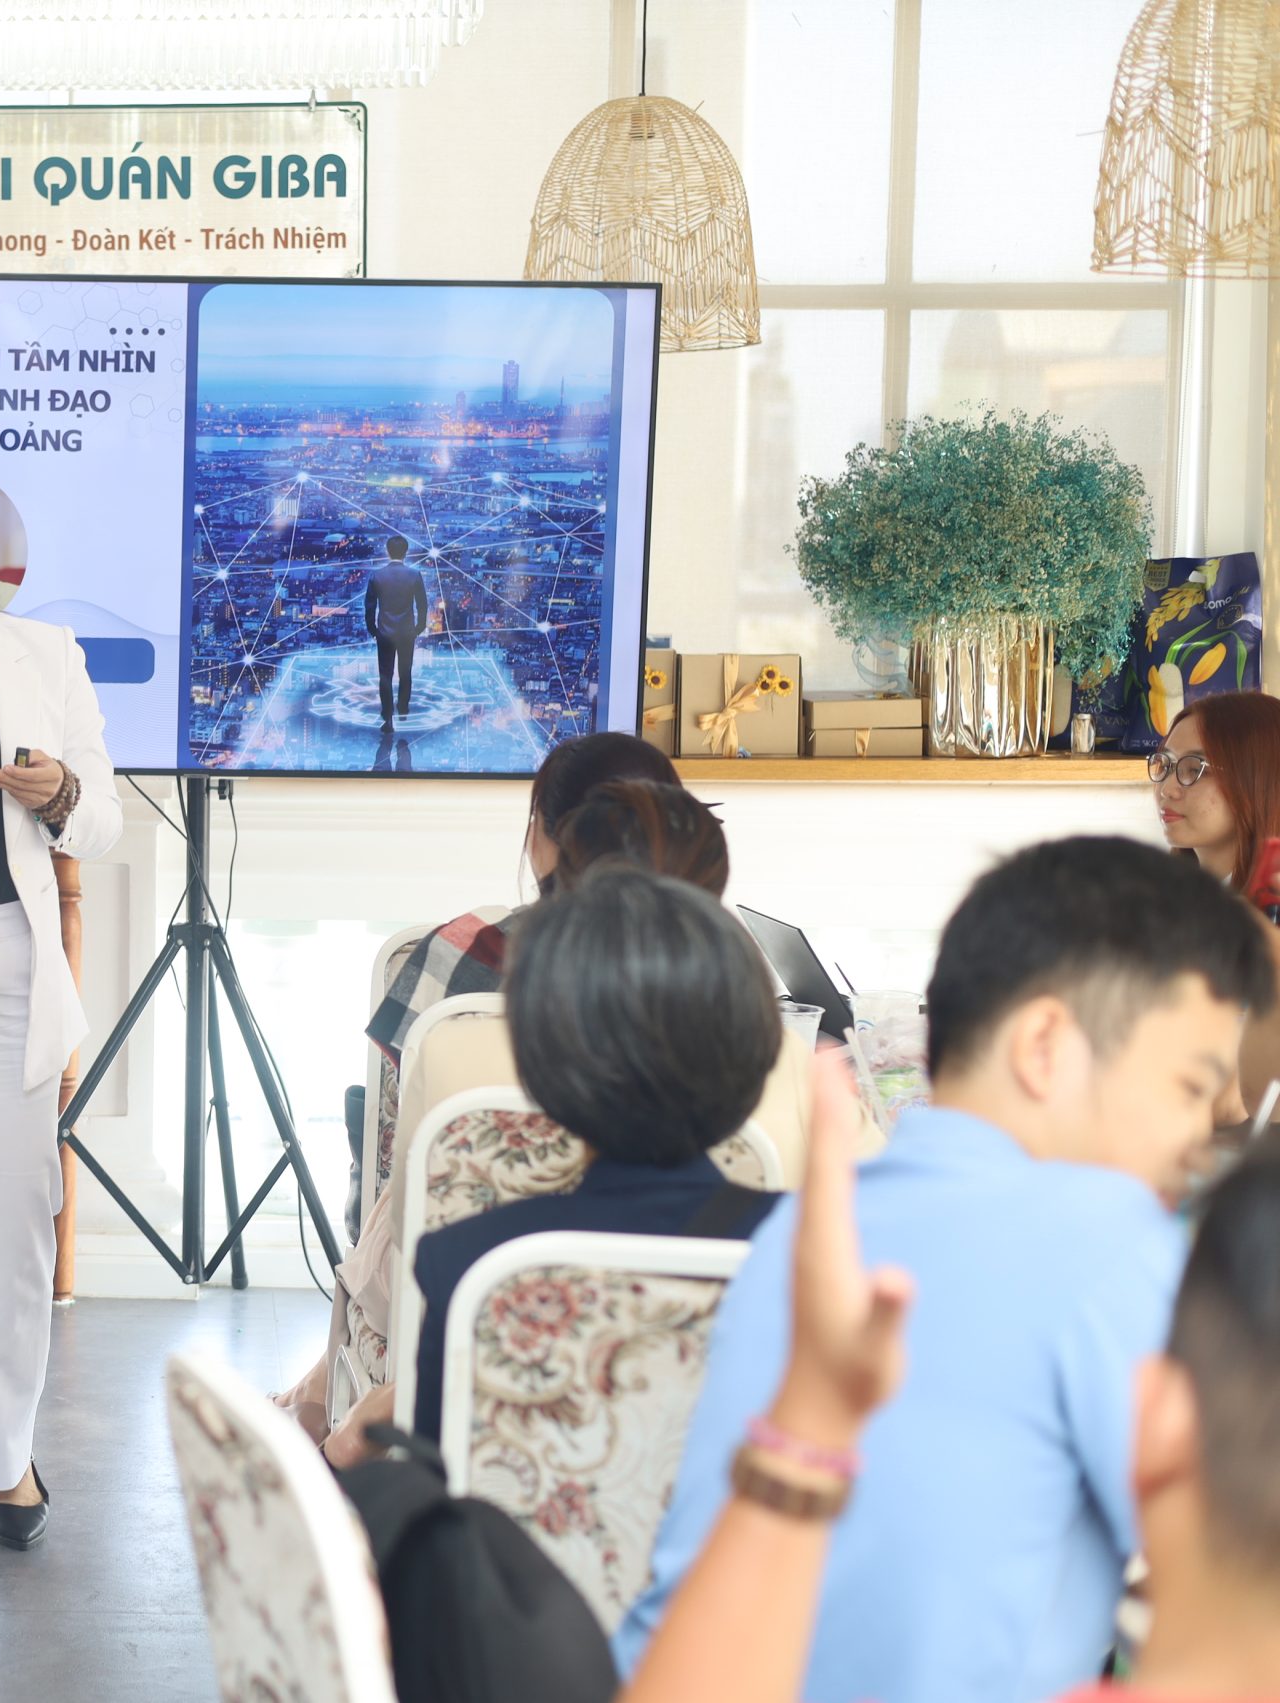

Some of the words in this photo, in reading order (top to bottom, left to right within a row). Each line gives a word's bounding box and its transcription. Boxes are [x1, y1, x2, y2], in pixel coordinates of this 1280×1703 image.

[33, 141, 192, 206] QUÁN
[213, 153, 347, 200] GIBA
[72, 228, 130, 250] Đoàn
[138, 226, 176, 250] Kết
[200, 226, 264, 250] Trách
[273, 226, 347, 254] Nhiệm
[7, 341, 70, 372] TẦM
[78, 341, 156, 373] NHÌN
[47, 389, 112, 418] ĐẠO
